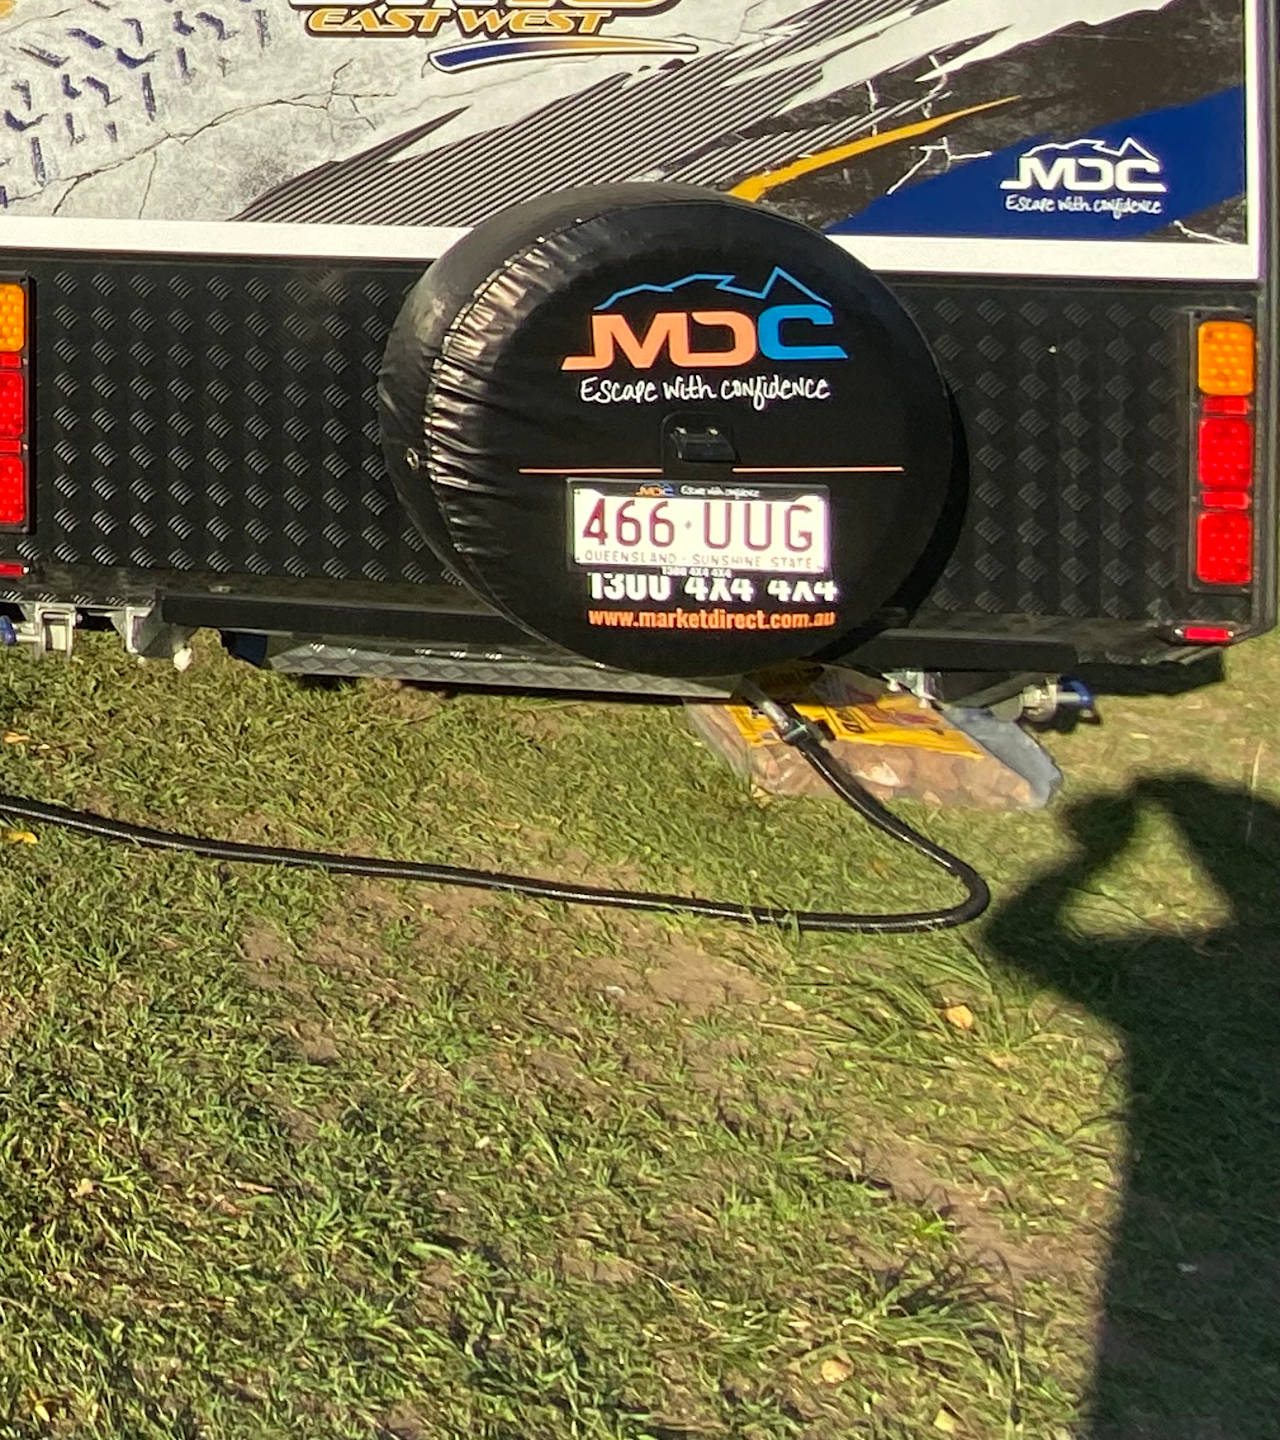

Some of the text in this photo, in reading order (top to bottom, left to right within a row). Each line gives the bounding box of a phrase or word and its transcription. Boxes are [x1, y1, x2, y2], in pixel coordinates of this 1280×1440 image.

[306, 8, 612, 34] EAST WEST
[1000, 157, 1167, 192] MDC
[561, 304, 848, 371] MDC
[580, 374, 831, 410] Escape with confidence
[582, 498, 813, 553] 466 UUG
[585, 550, 812, 569] QUEENSLAND SUNSHINE STATE
[587, 572, 671, 601] 1300
[684, 575, 754, 602] 4X4
[588, 608, 836, 630] www.marketdirect.com.au
